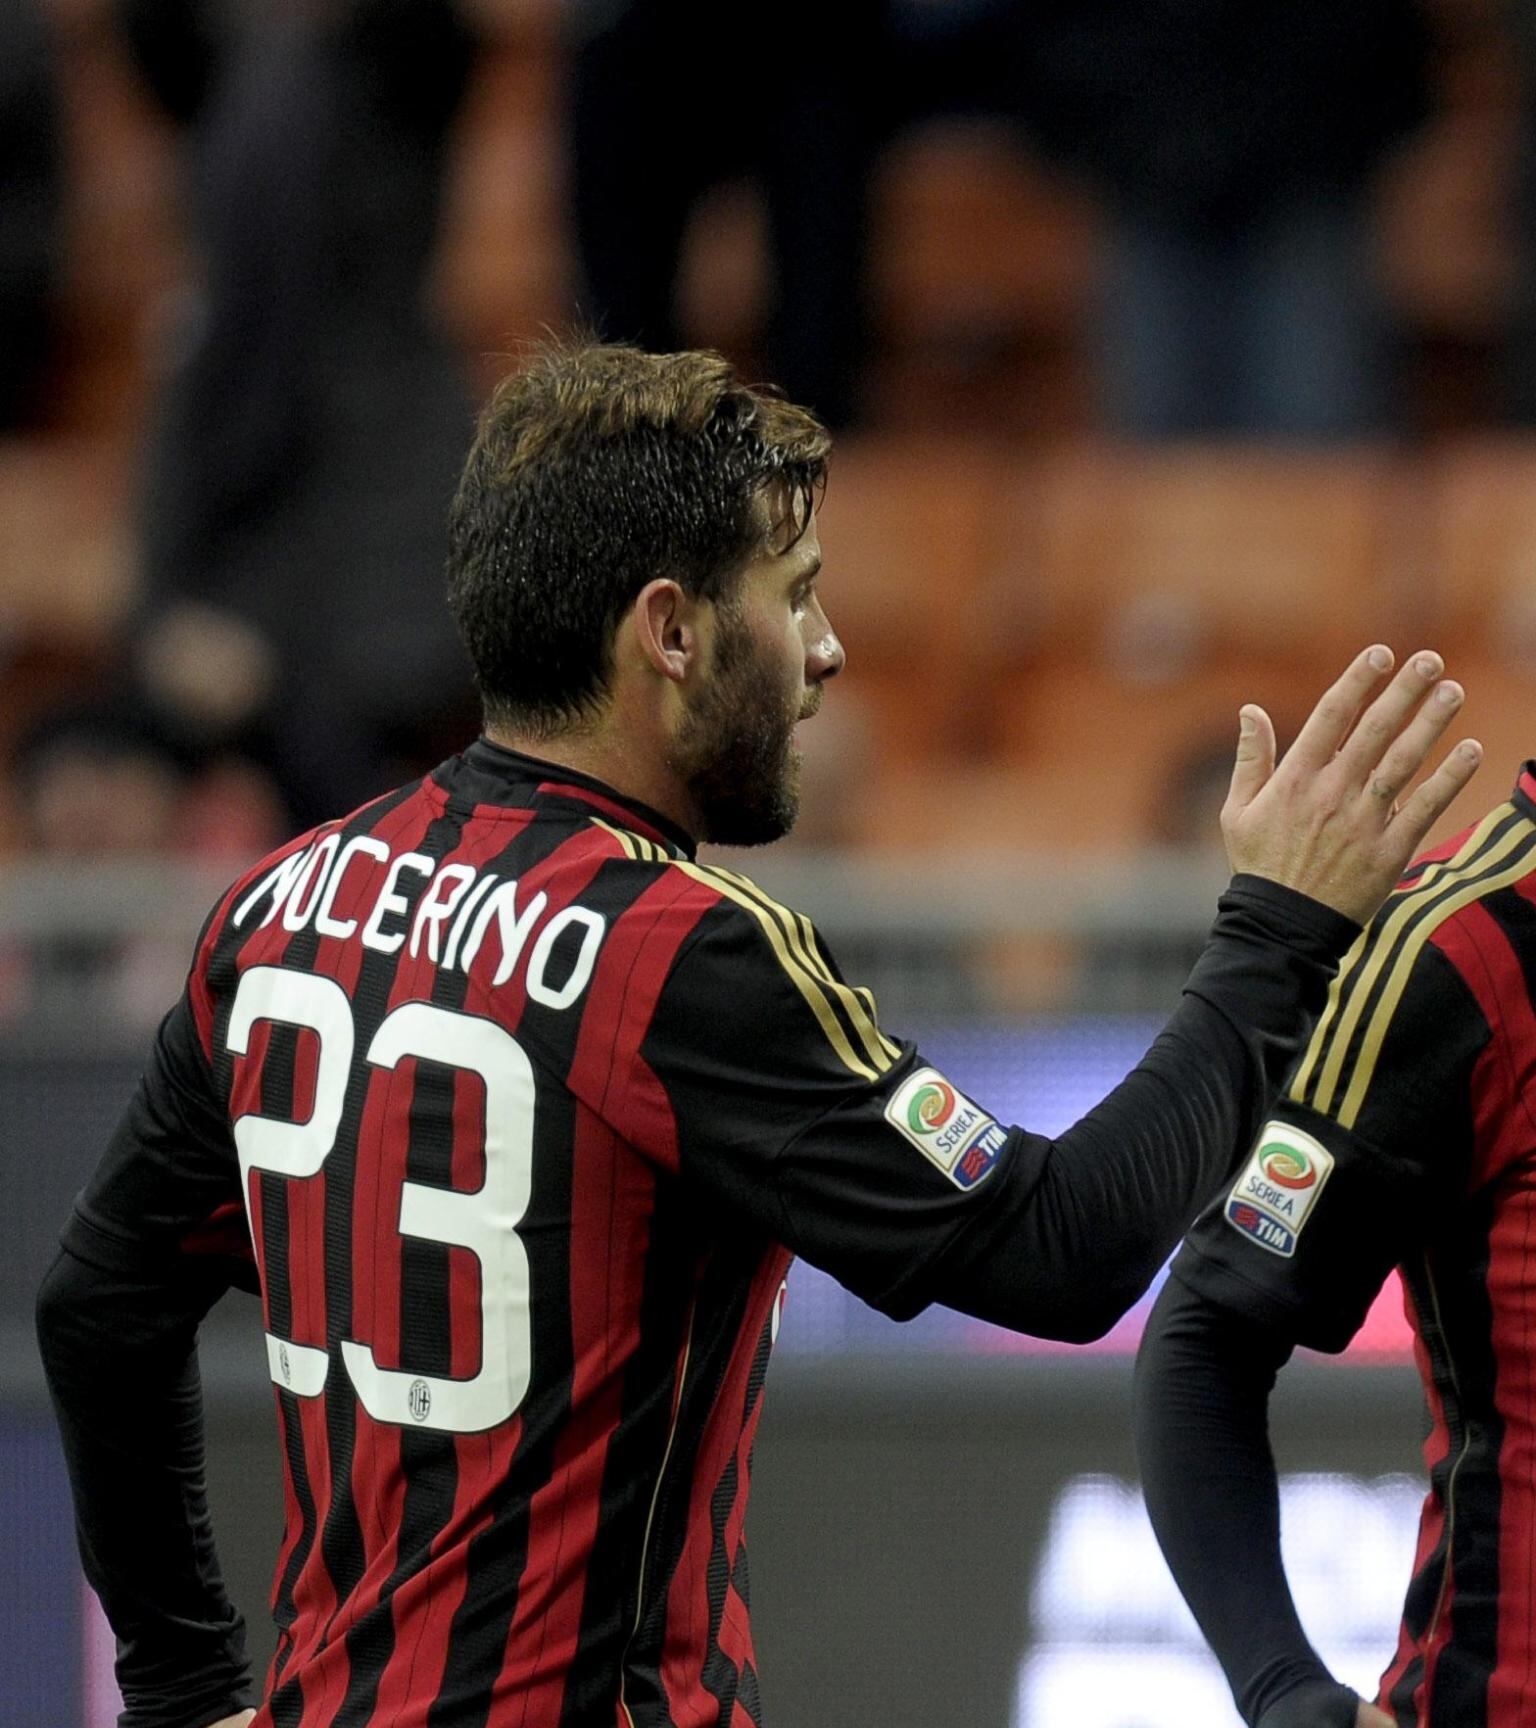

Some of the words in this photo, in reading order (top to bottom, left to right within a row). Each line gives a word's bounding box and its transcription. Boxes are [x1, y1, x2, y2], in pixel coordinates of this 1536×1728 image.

[232, 834, 606, 1011] NOCERINO
[964, 1108, 978, 1121] A
[978, 1125, 1008, 1157] TIM
[226, 964, 536, 1432] 23
[1246, 1176, 1283, 1209] SERIE
[1281, 1198, 1295, 1216] A
[1256, 1218, 1288, 1249] TIM
